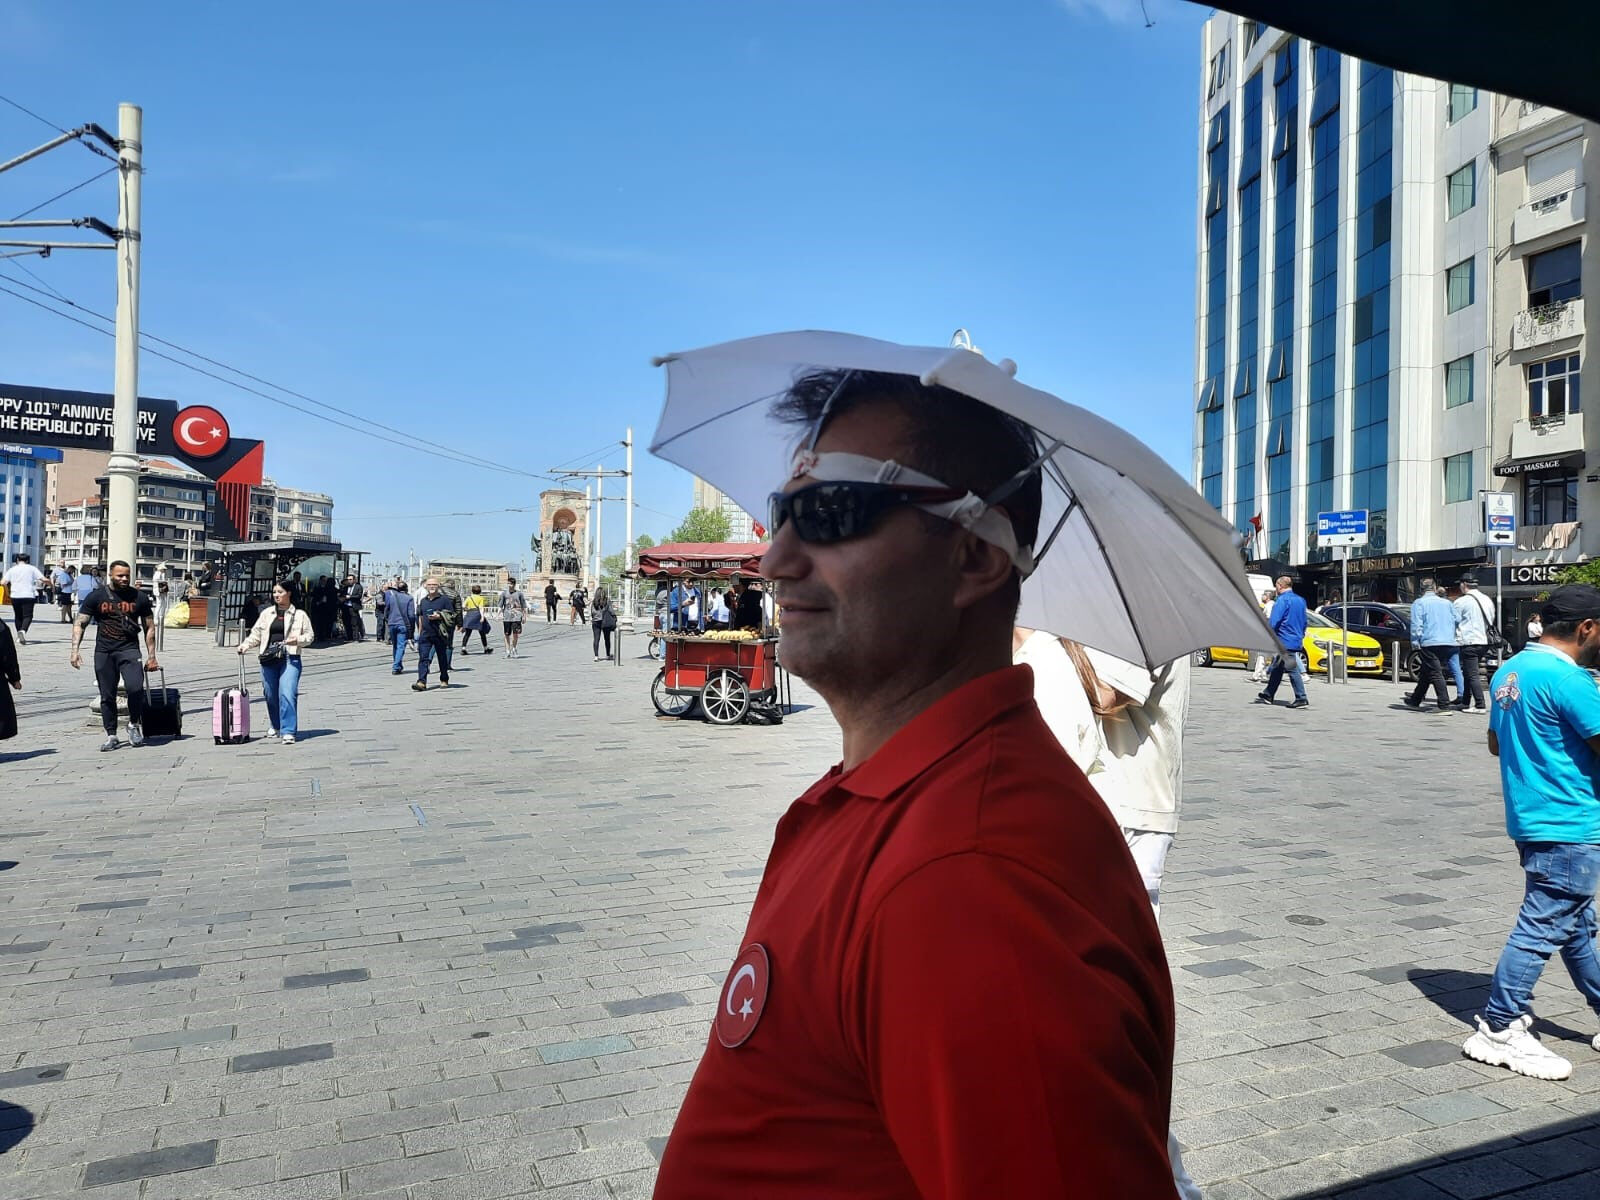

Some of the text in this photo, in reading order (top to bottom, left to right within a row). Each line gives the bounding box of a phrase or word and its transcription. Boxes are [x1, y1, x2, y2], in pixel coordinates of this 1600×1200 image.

[61, 403, 157, 425] ANNIVERY
[20, 416, 83, 435] REPUBLIC
[84, 421, 101, 436] OF
[1500, 459, 1561, 475] FOOT MASSAGE
[1511, 566, 1559, 583] LORIS
